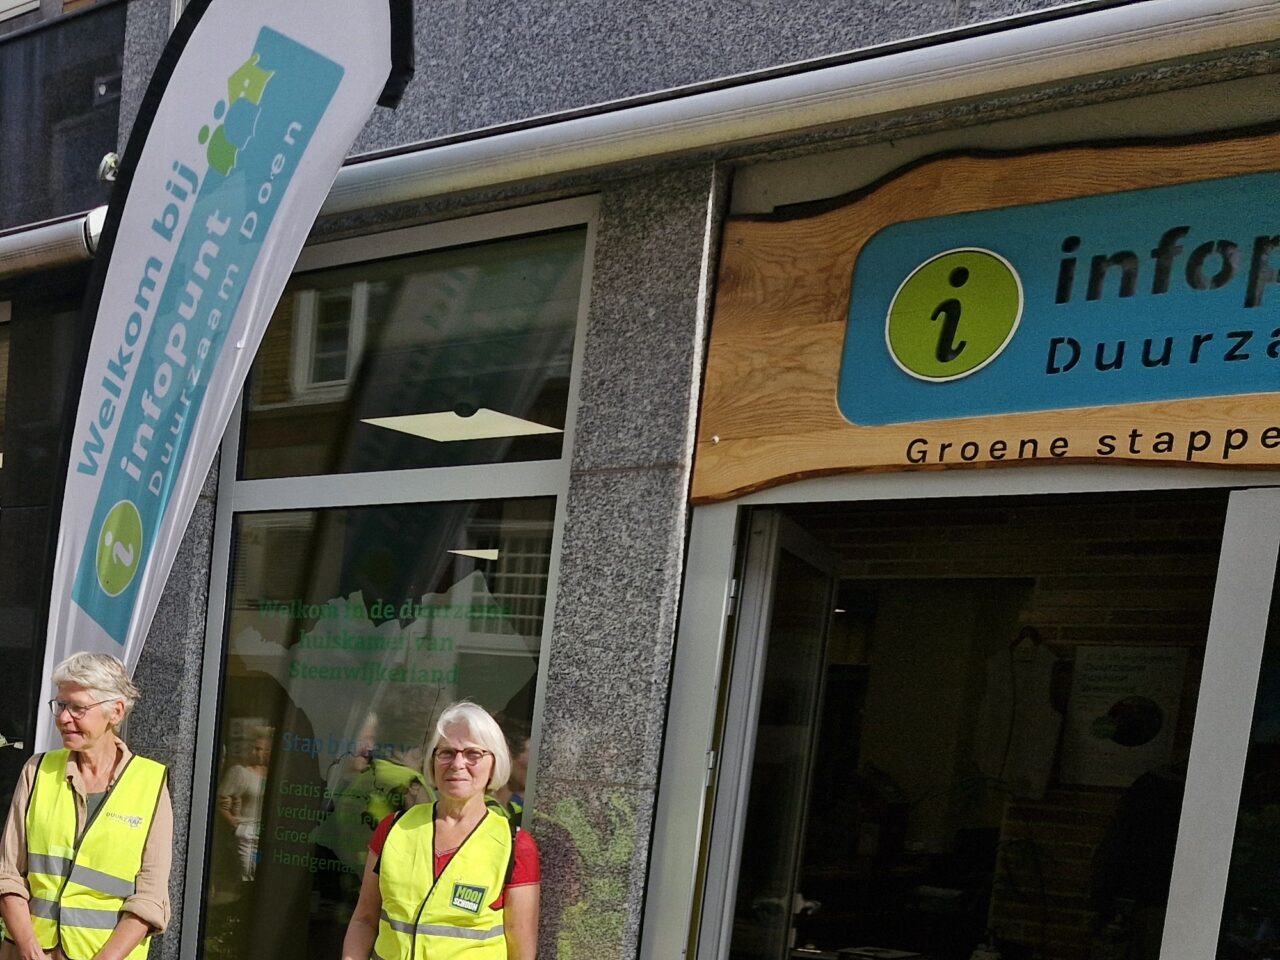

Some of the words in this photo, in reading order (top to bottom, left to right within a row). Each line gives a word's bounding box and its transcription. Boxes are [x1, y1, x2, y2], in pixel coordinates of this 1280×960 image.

[76, 255, 163, 477] Welkom
[151, 160, 199, 242] bij
[148, 263, 240, 496] Duurzaam
[239, 121, 303, 239] Doen
[121, 209, 231, 482] infopunt
[906, 438, 1071, 464] Groene
[1096, 427, 1280, 461] stappe
[258, 599, 341, 620] Welkom
[371, 598, 395, 620] de
[414, 636, 454, 651] van
[288, 660, 462, 685] Steenwijkerland
[282, 732, 320, 758] Stap
[279, 779, 320, 797] Gratis
[456, 885, 483, 904] MOOI
